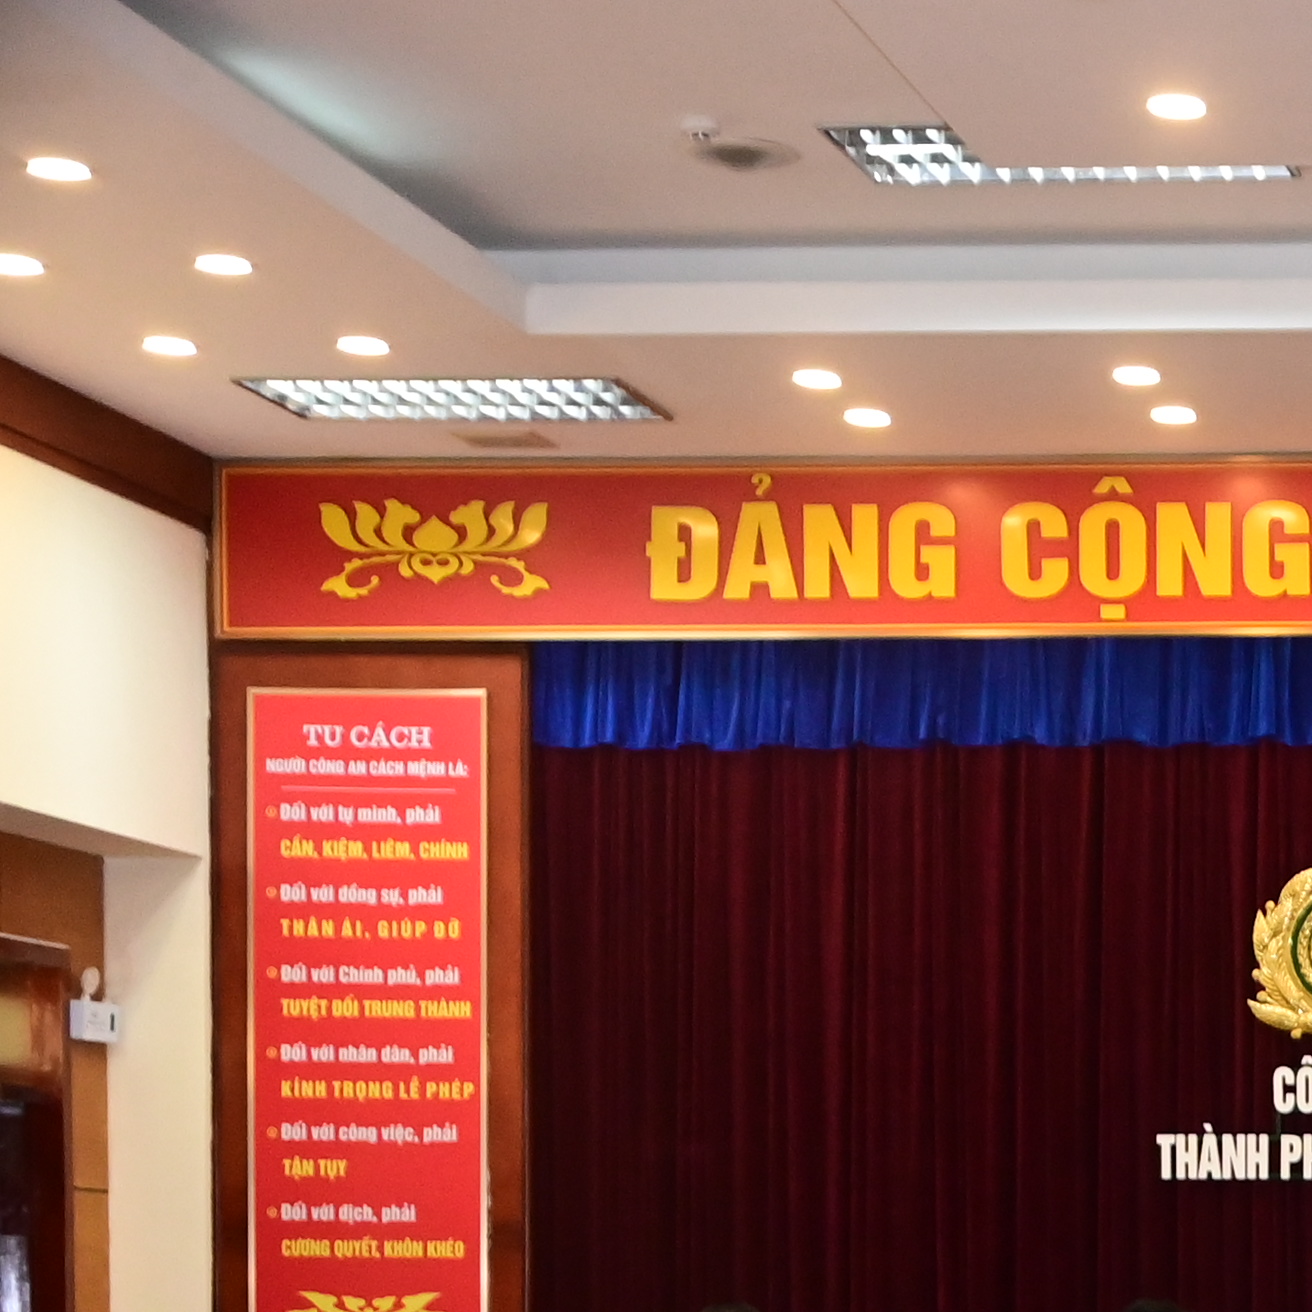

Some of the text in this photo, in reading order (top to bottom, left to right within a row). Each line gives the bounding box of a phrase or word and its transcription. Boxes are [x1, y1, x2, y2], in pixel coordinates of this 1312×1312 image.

[646, 475, 956, 602] ĐẢNG
[1001, 477, 1310, 620] CỘNG
[1156, 1123, 1269, 1180] THÀNH
